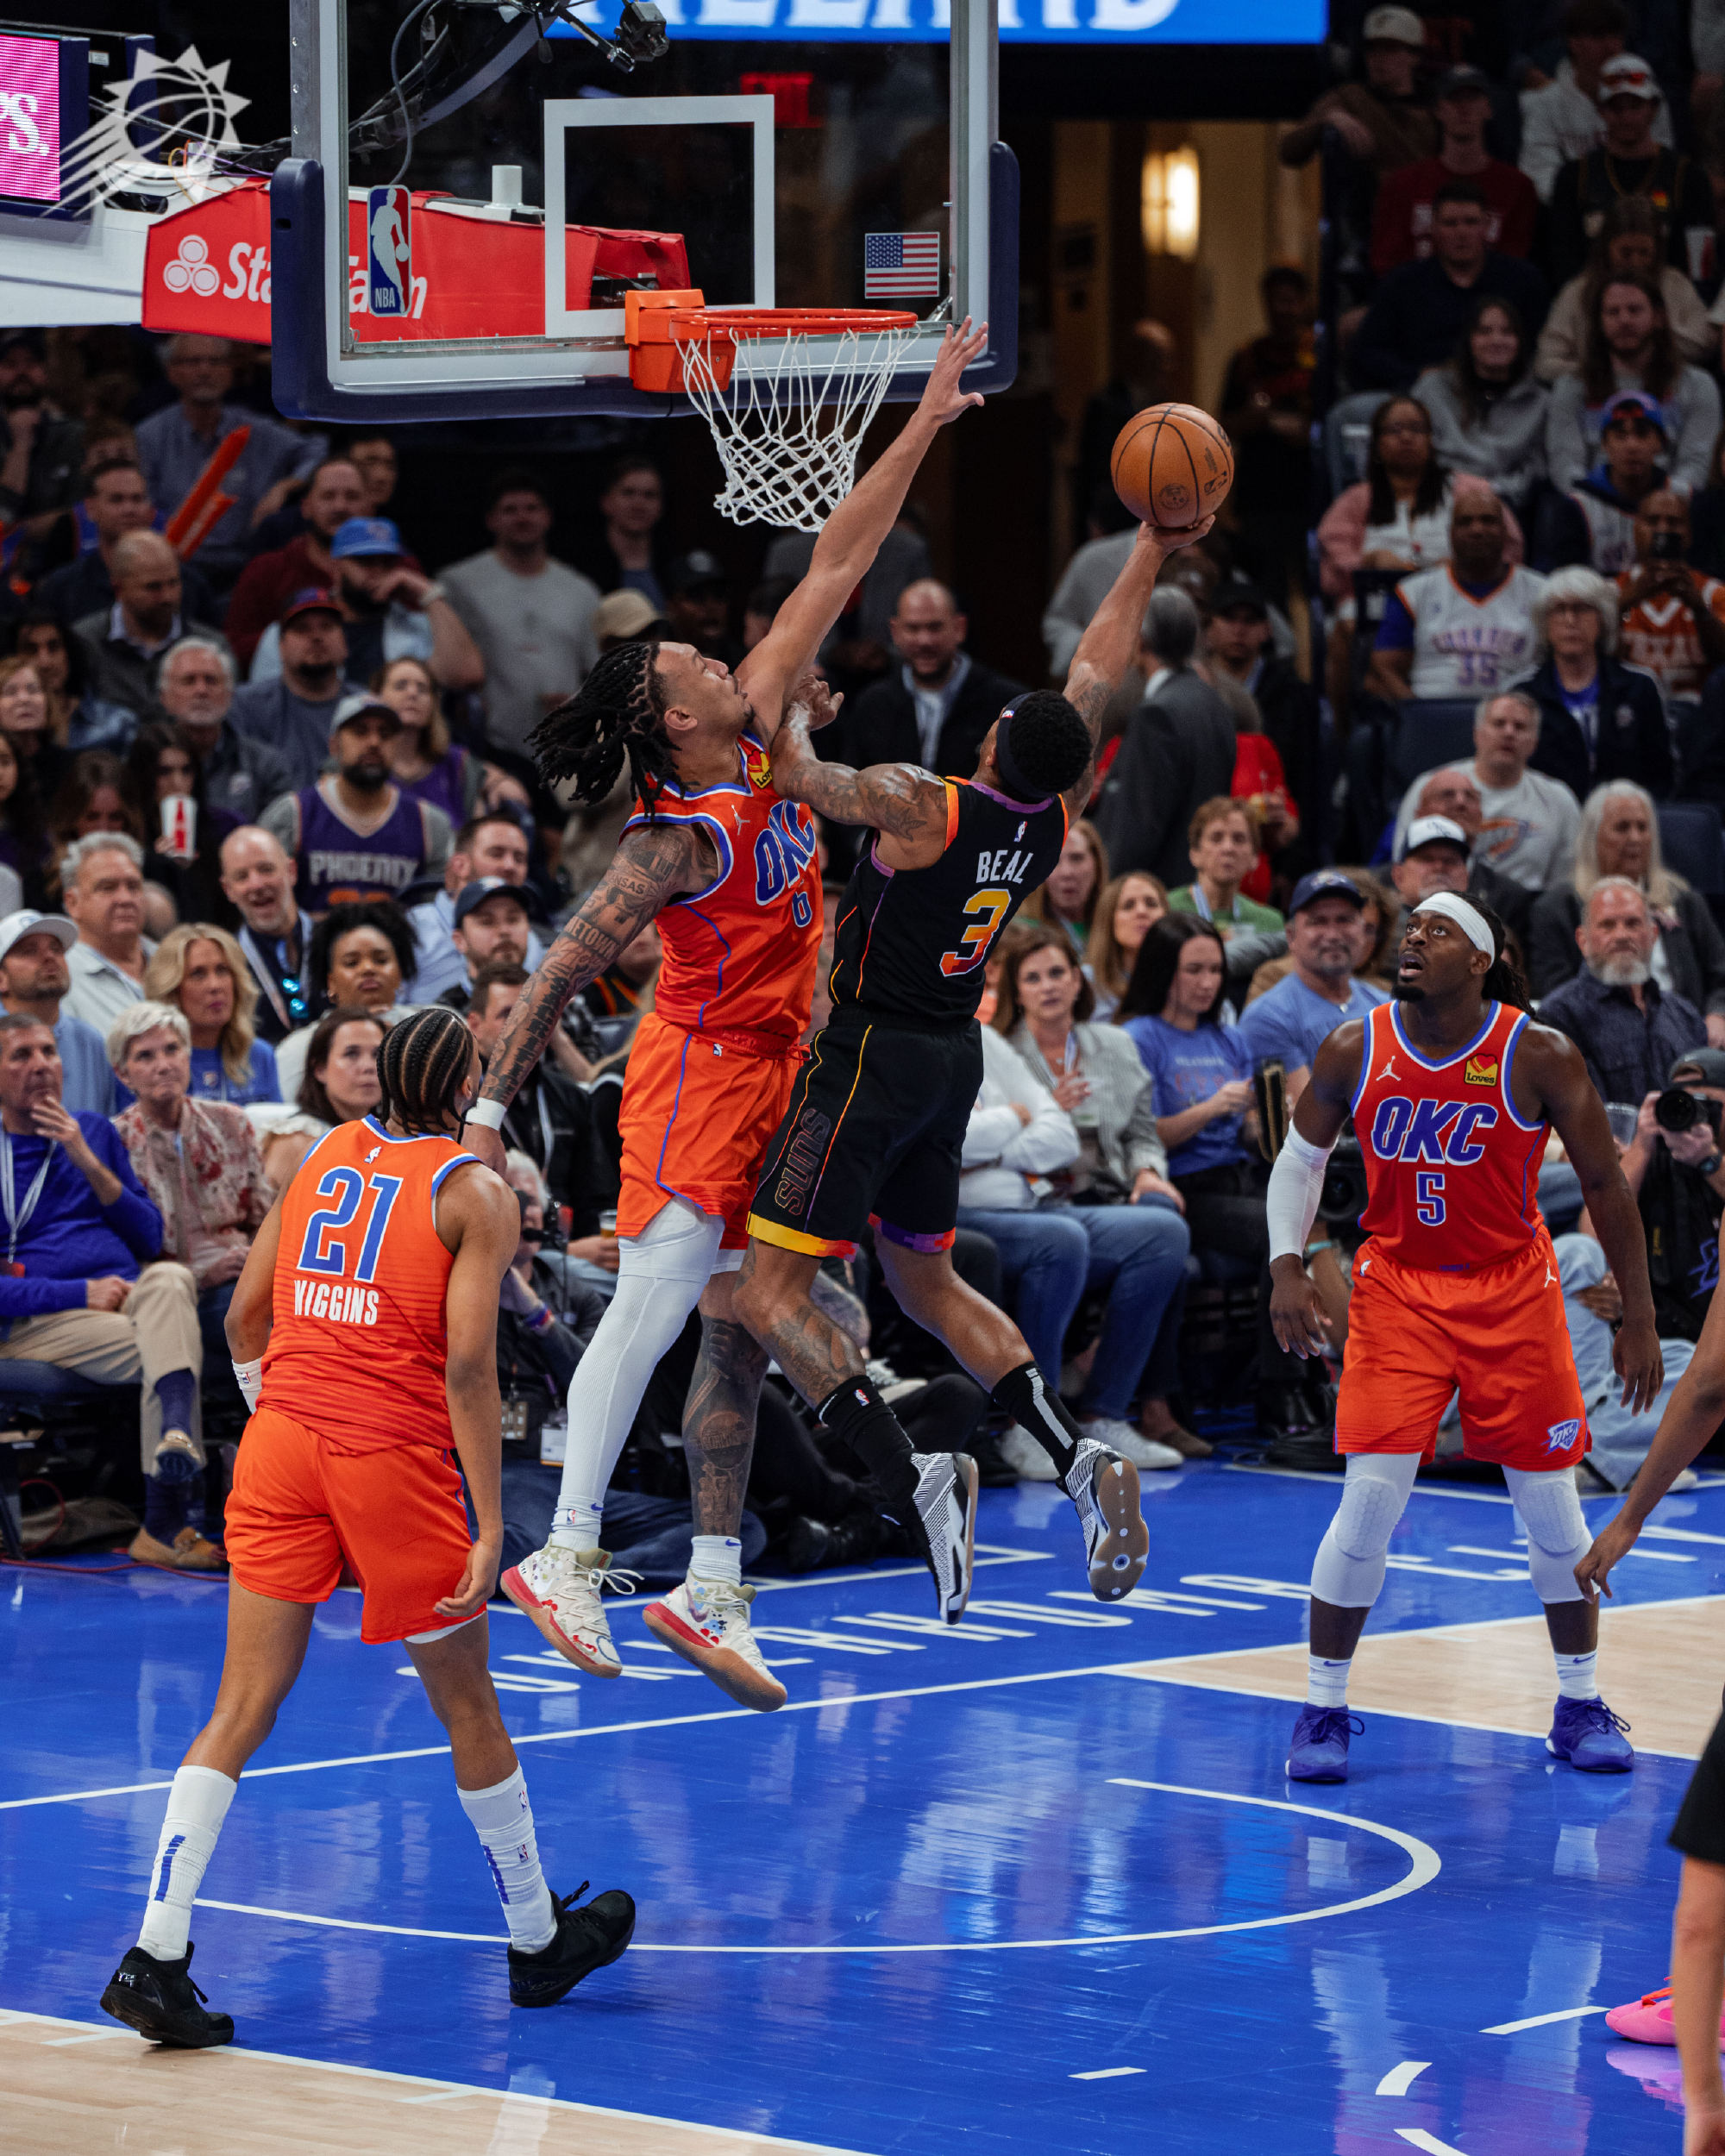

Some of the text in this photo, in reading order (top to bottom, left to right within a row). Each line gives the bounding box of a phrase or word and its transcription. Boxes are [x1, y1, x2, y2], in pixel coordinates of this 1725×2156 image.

[374, 286, 396, 309] NBA
[754, 799, 816, 906] OKC
[975, 849, 1033, 884] BEAL
[939, 888, 1012, 978] 3
[775, 1107, 831, 1216] SUNS
[1371, 1096, 1498, 1166] OKC
[296, 1165, 405, 1284] 21
[1416, 1170, 1446, 1226] 5
[293, 1279, 380, 1326] WIGGINS
